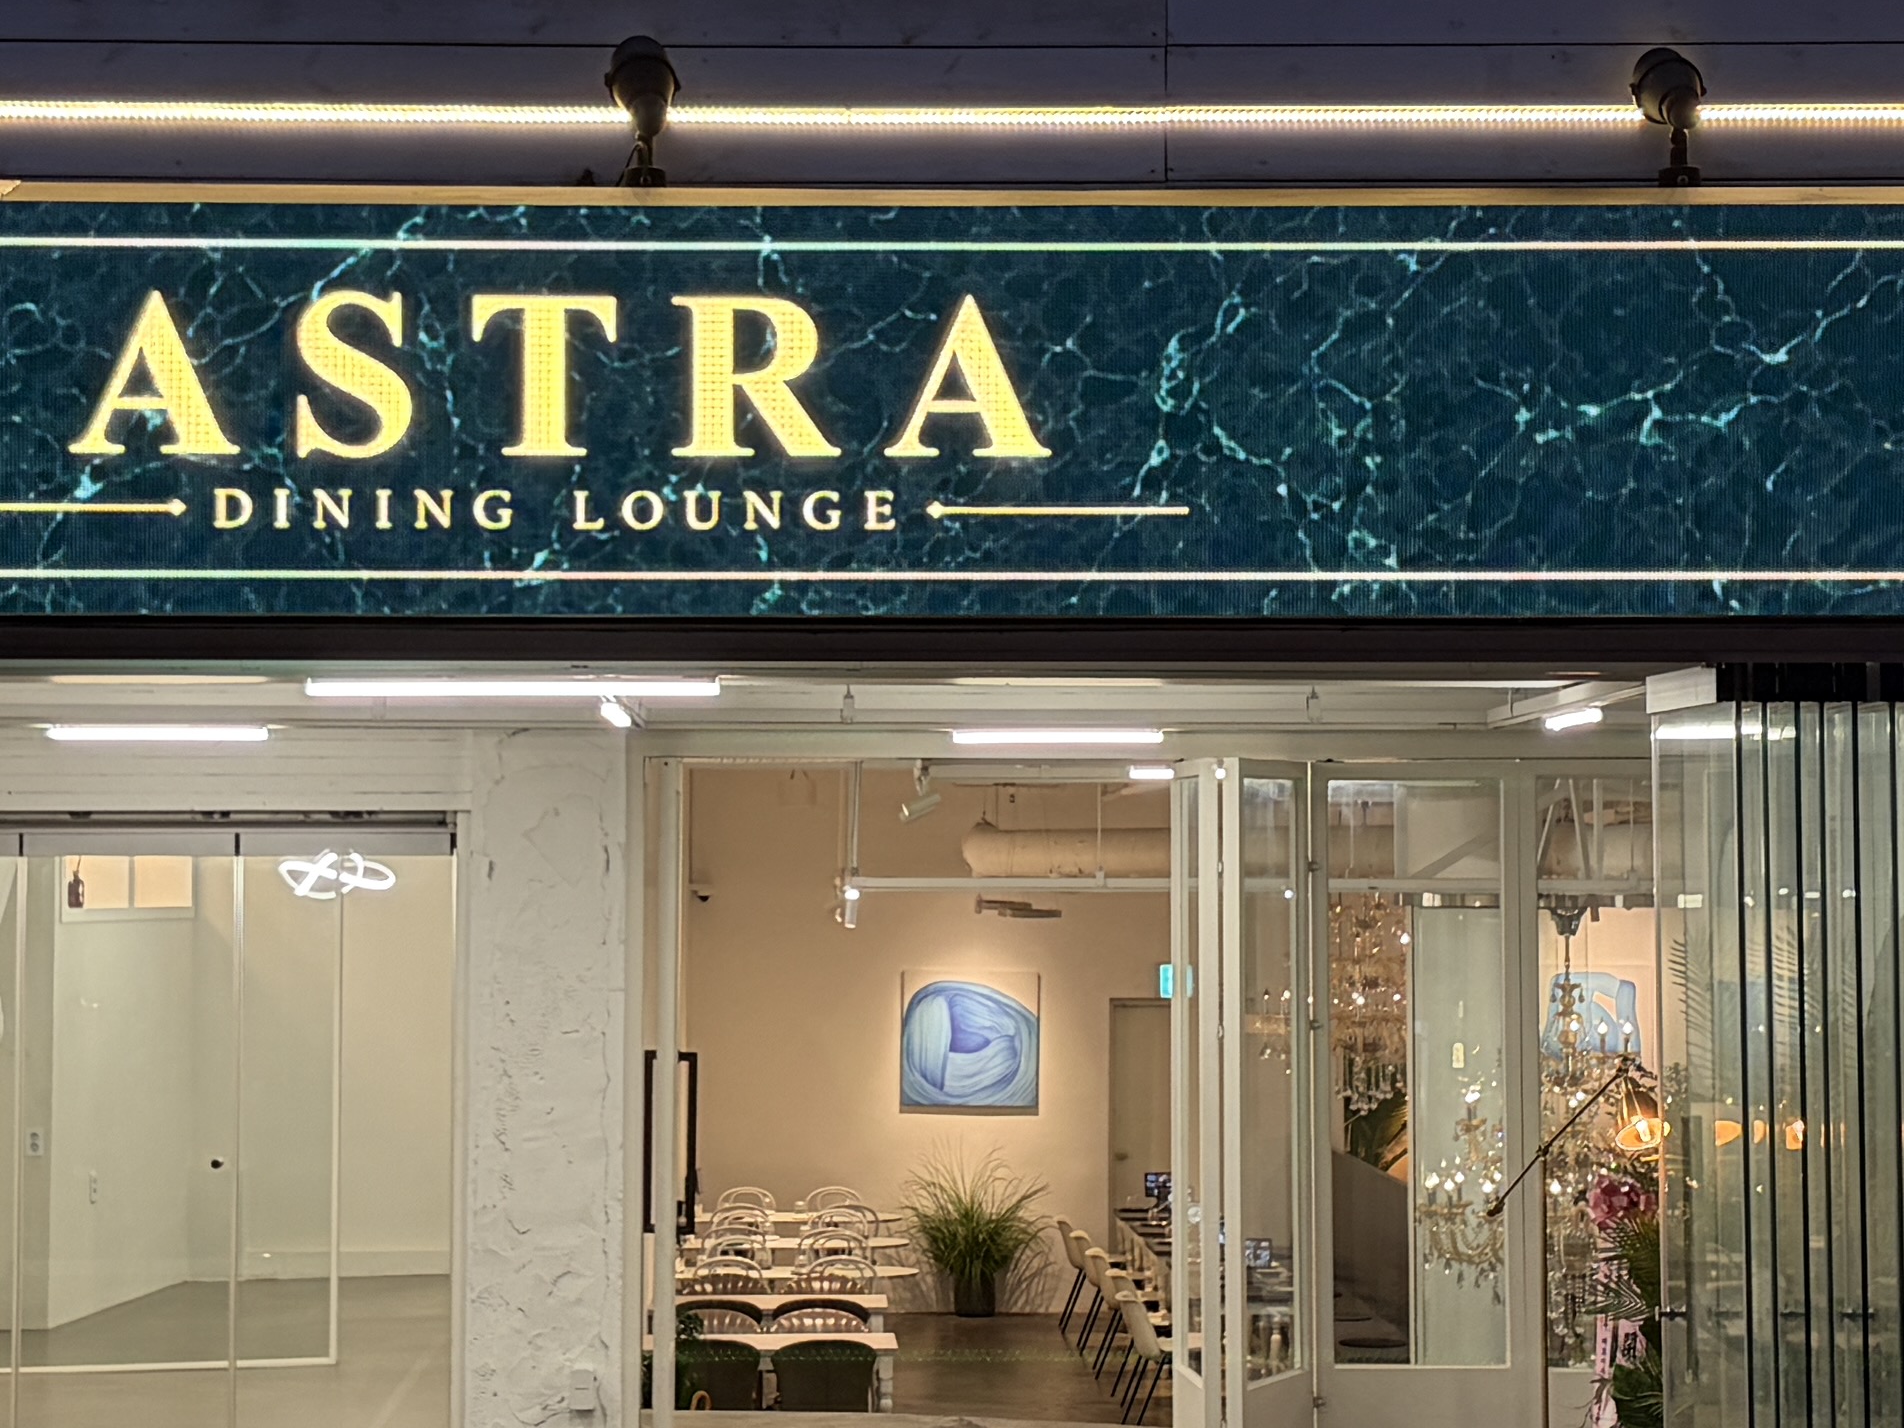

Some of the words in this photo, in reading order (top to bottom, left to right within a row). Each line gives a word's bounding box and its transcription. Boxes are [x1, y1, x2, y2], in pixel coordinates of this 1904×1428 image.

[68, 290, 1052, 459] ASTRA
[212, 487, 514, 531] DINING
[572, 489, 898, 533] LOUNGE
